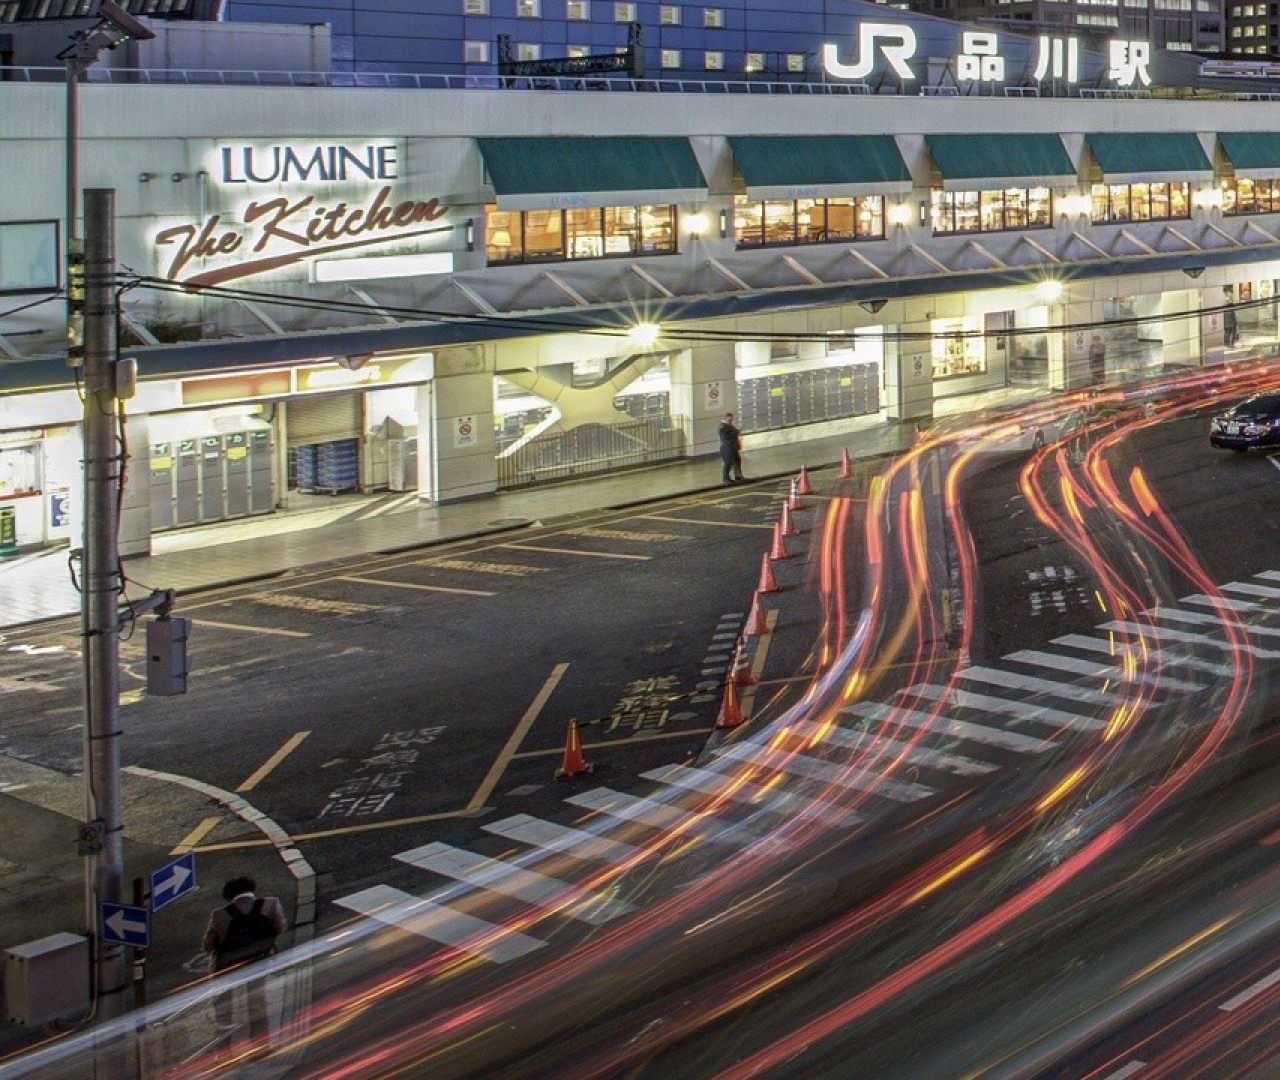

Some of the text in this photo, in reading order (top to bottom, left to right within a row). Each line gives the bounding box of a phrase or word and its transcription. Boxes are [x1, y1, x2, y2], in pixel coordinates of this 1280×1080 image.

[824, 23, 1152, 87] JR 品川駅
[221, 146, 397, 184] LUMINE
[155, 185, 450, 280] The Kitchen
